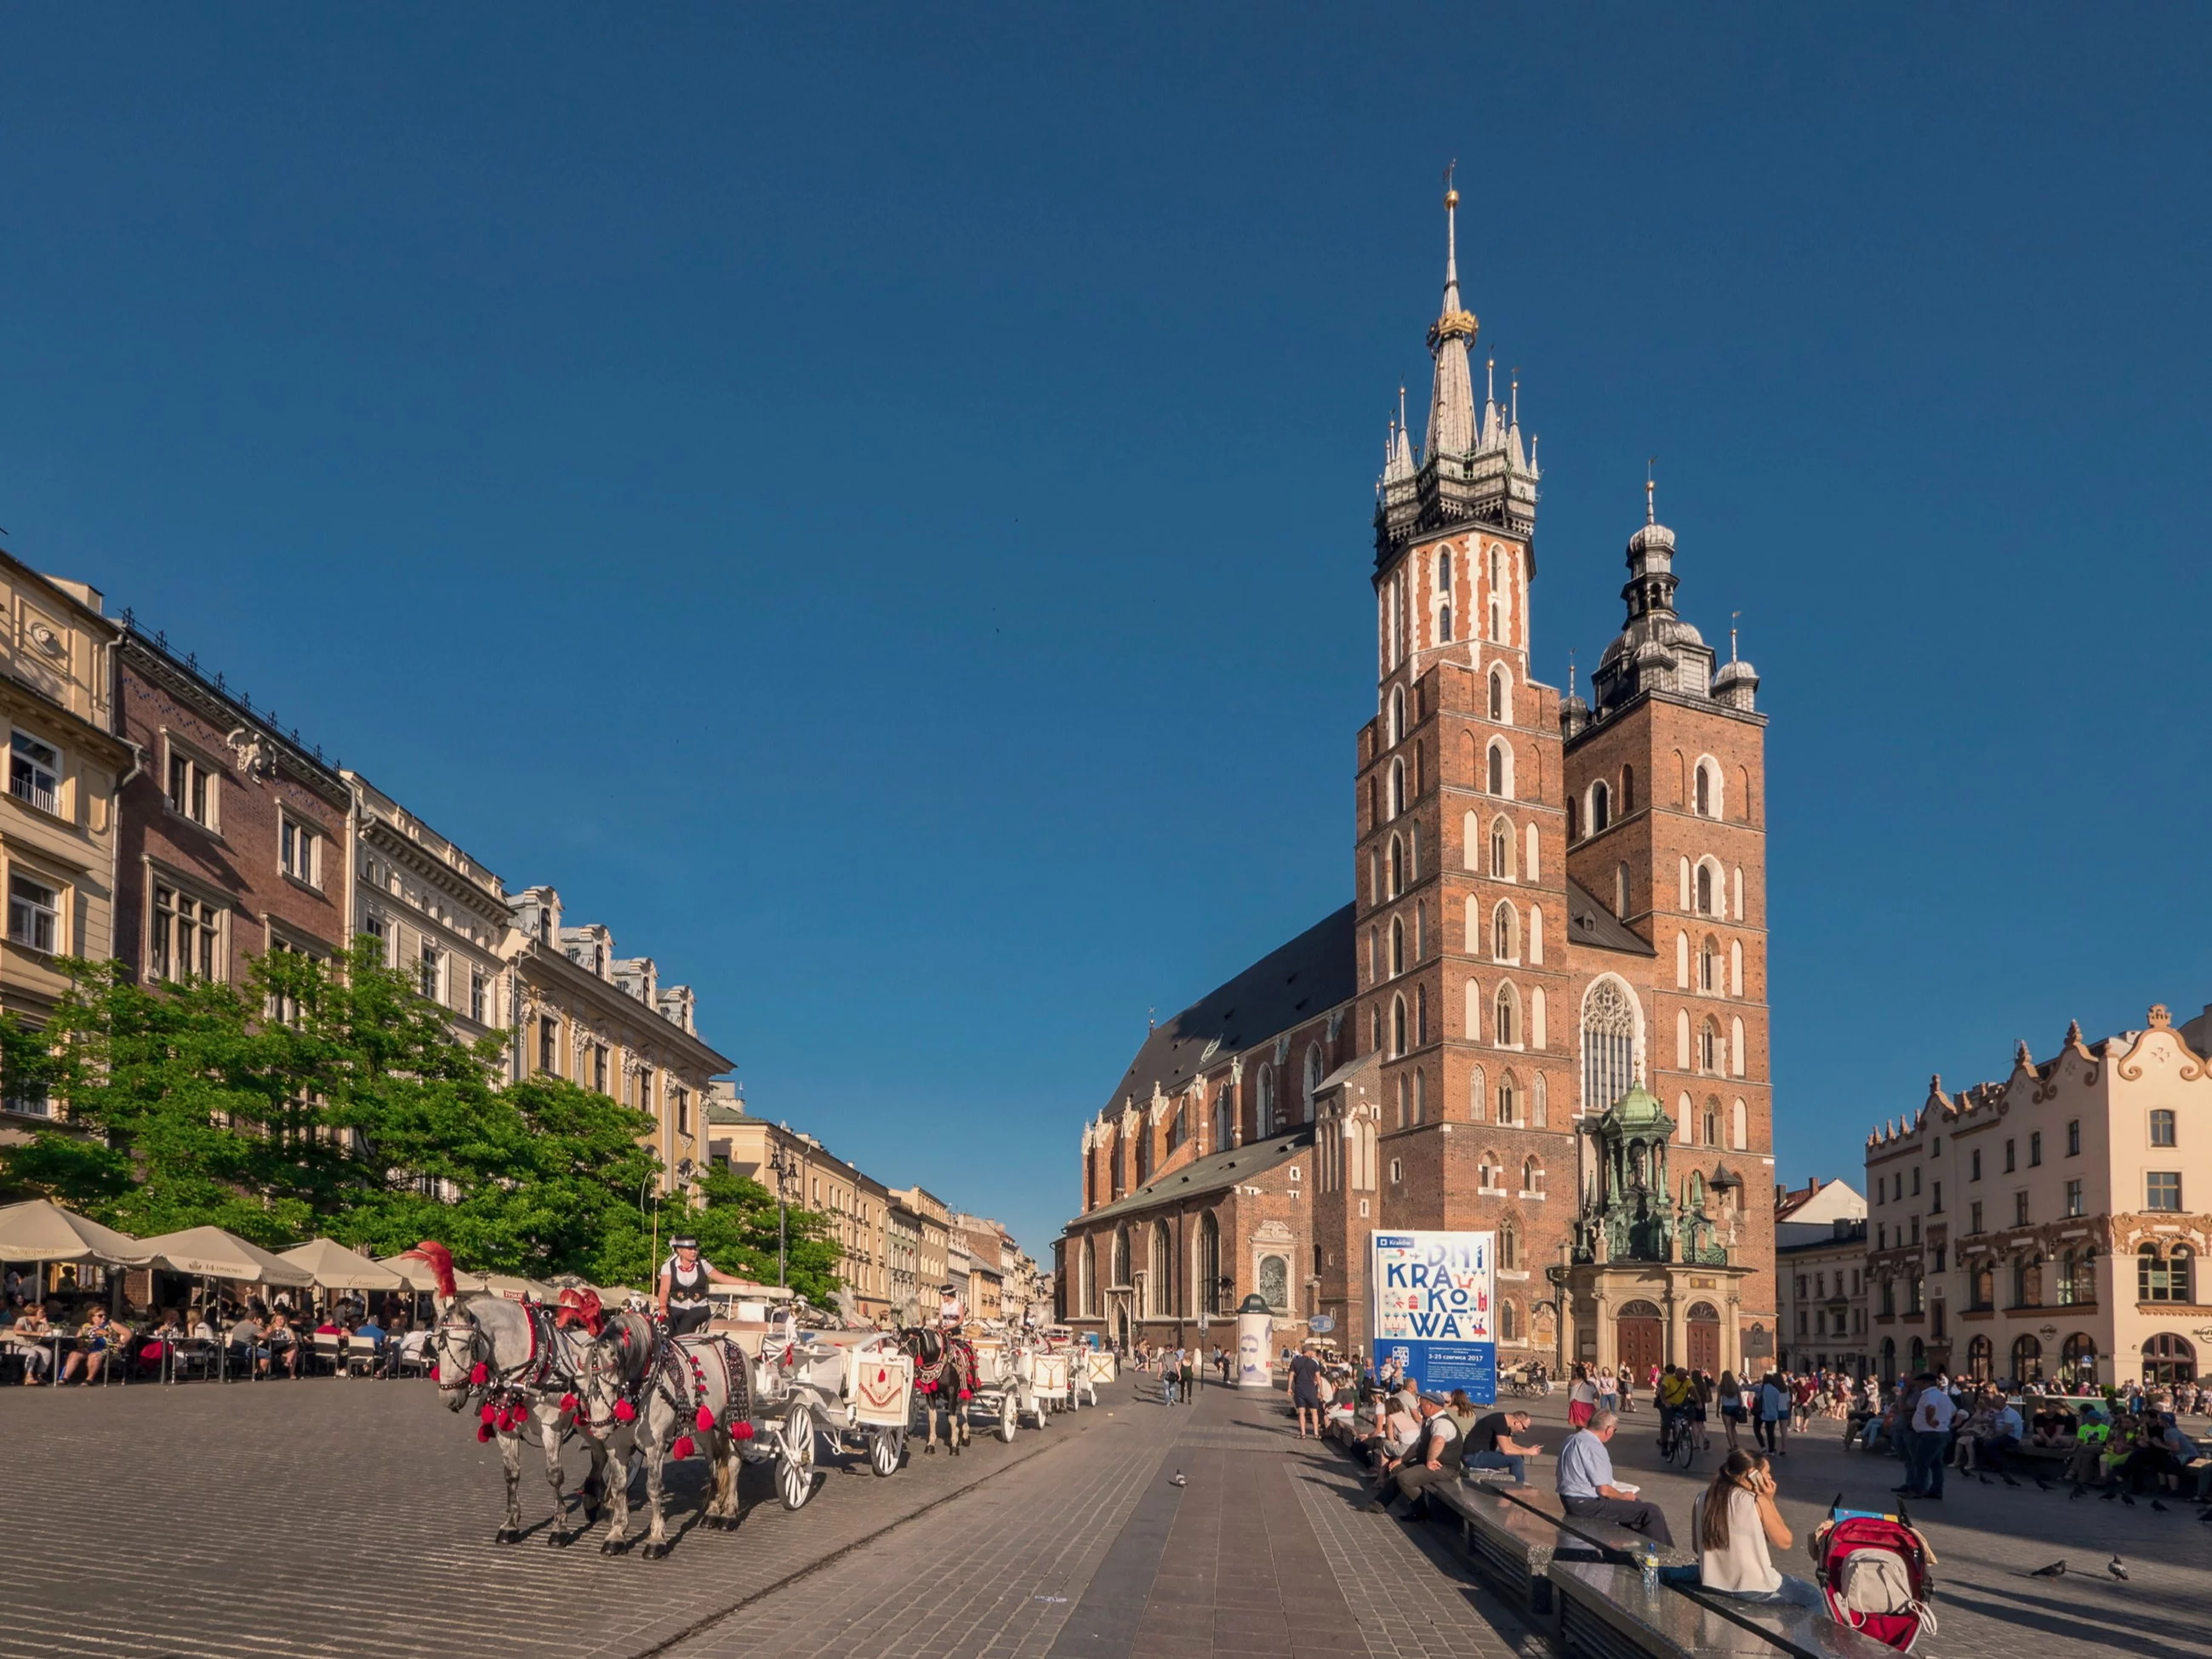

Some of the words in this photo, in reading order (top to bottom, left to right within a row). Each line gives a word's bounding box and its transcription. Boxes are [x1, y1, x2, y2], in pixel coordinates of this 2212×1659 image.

[1388, 1263, 1453, 1289] KRA
[1428, 1288, 1468, 1313] KO
[1408, 1313, 1461, 1338] WA
